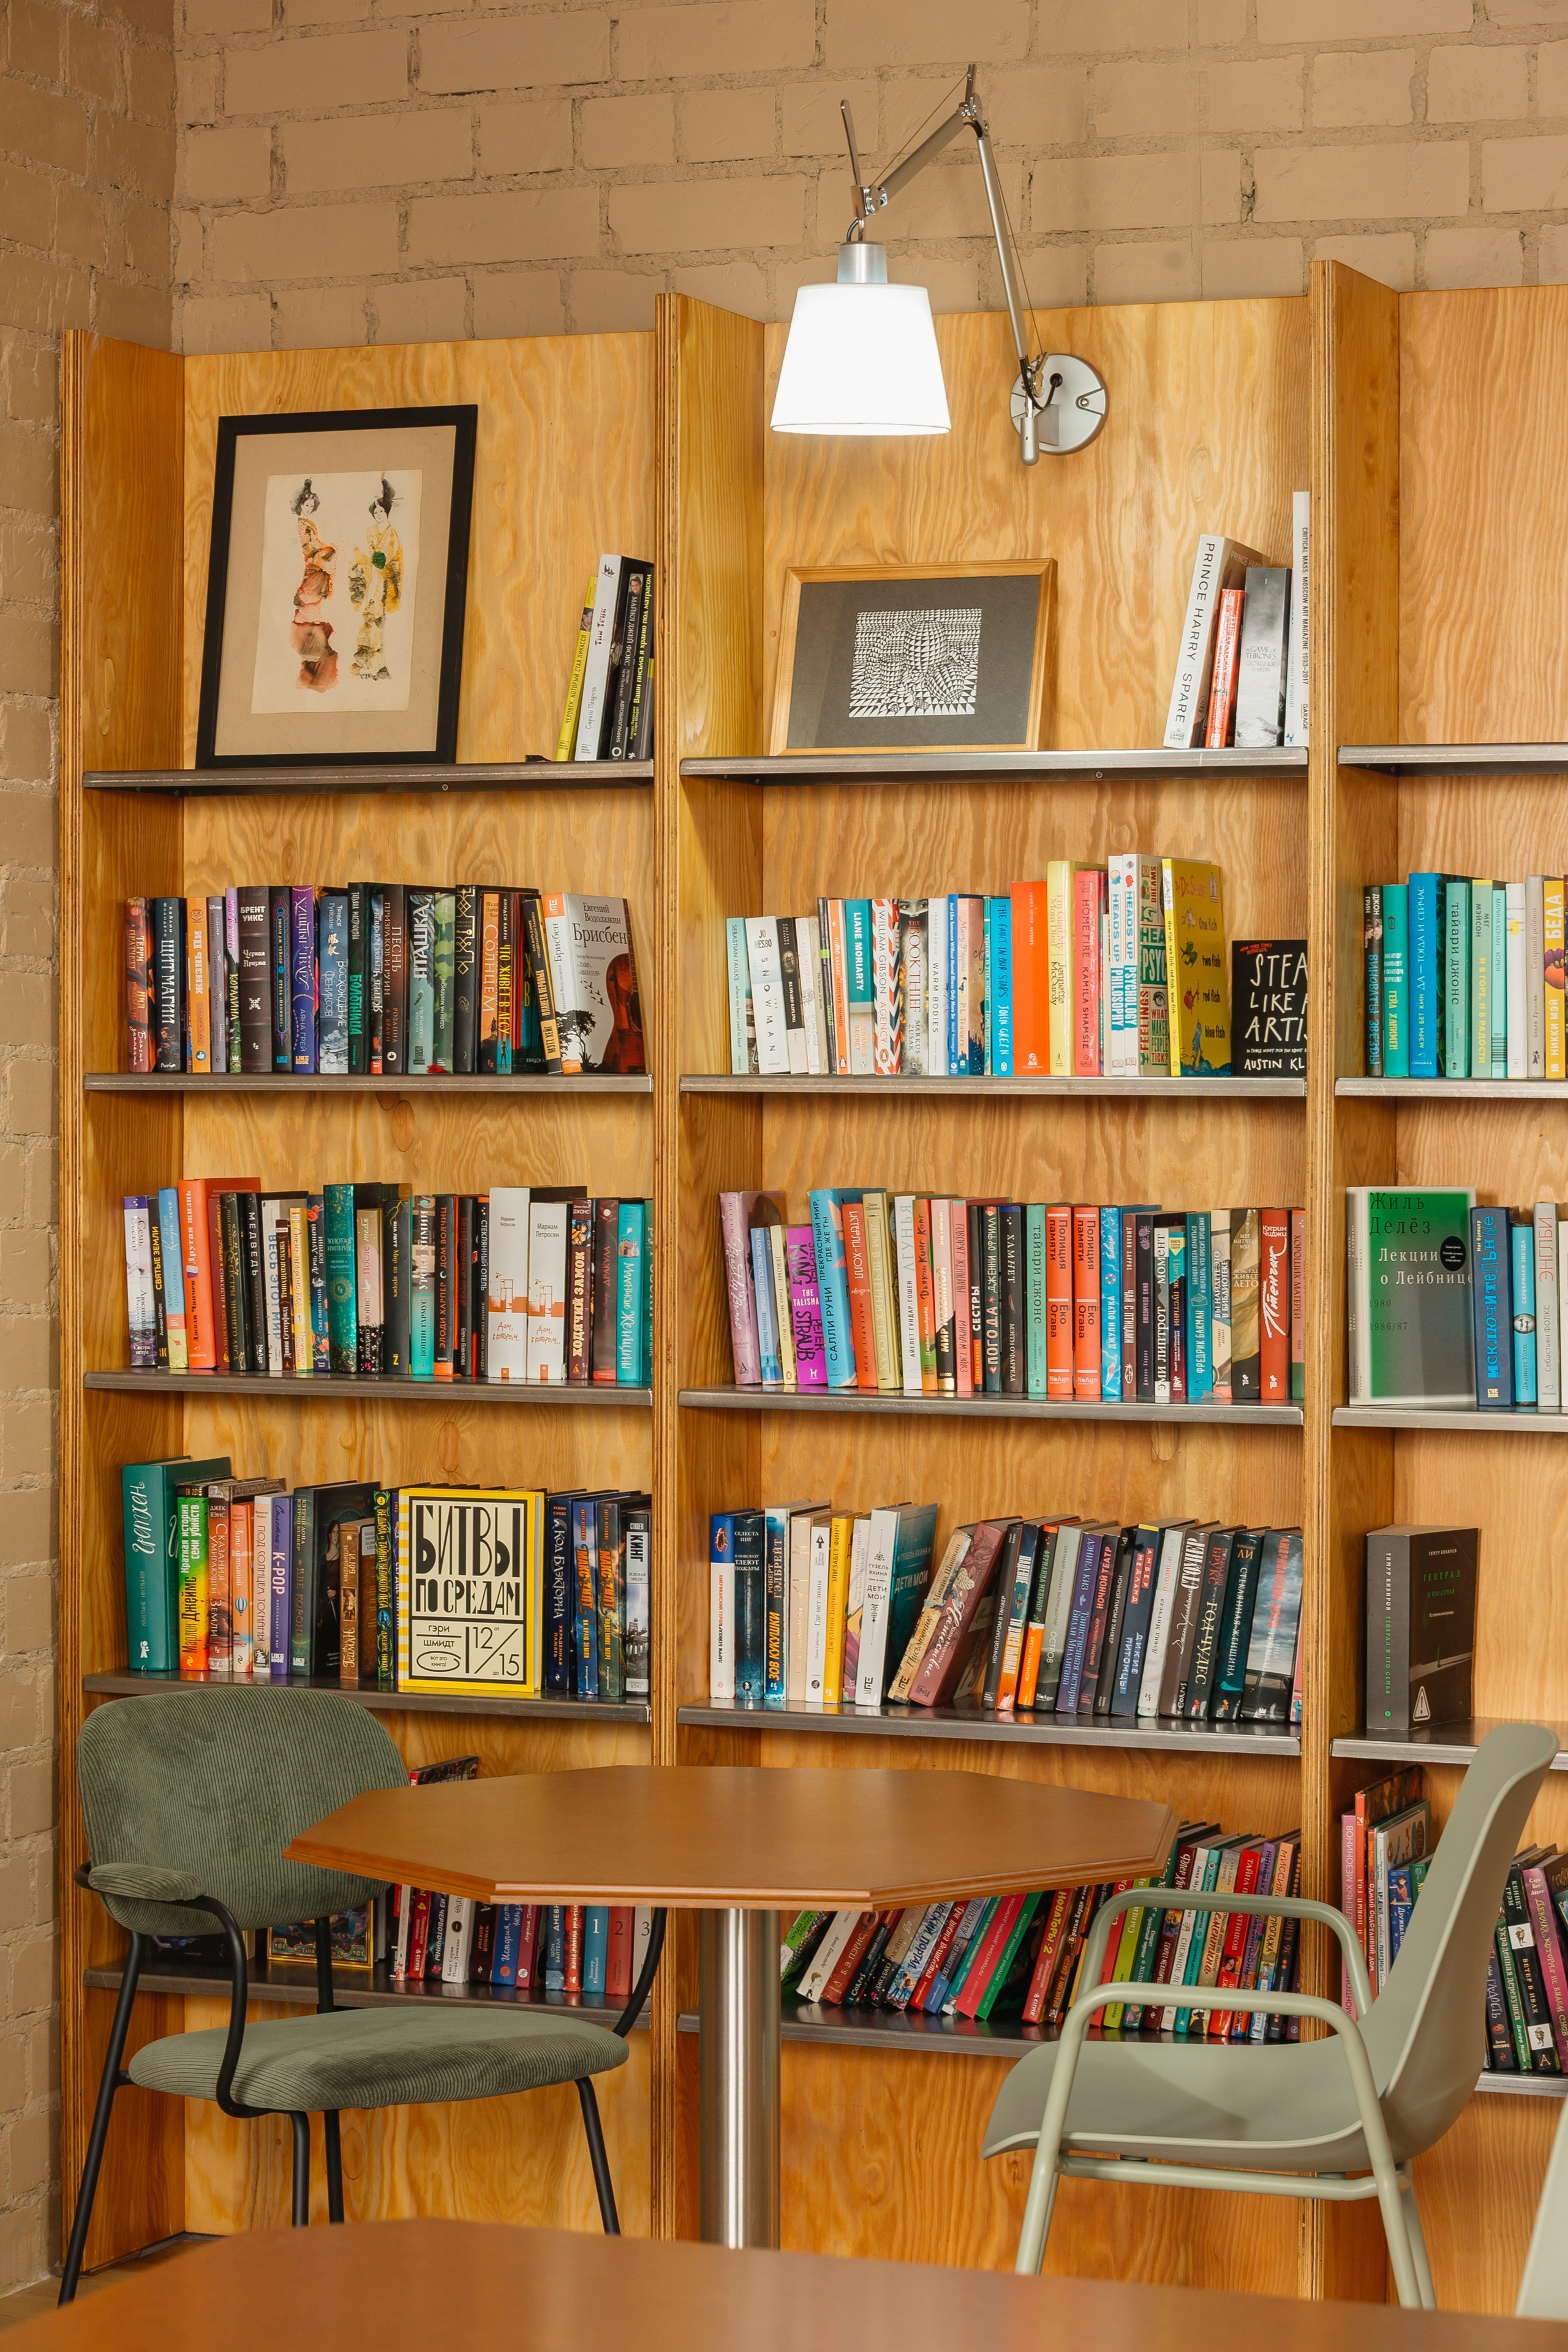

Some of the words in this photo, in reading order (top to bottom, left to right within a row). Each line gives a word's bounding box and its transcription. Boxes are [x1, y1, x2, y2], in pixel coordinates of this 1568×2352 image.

[1197, 543, 1215, 601] PRINCE
[576, 635, 587, 658] ПИКАССО
[639, 625, 648, 649] храню
[1186, 608, 1203, 661] HARRY
[570, 674, 579, 698] КОТОРЫЙ
[1175, 673, 1193, 723] SPARE
[565, 699, 576, 723] ЧЕЛОВЕК,
[583, 902, 610, 913] Евгений
[585, 913, 621, 924] Водолазкин
[1415, 886, 1425, 920] СЕЙЧАС
[1545, 894, 1562, 938] БЕДА
[573, 923, 628, 948] Брисбен
[853, 912, 862, 939] LIANE
[160, 940, 174, 972] ЩИТ
[499, 944, 510, 960] ЧТО
[552, 922, 563, 962] Брисбен
[909, 927, 920, 968] BOOK
[1127, 941, 1134, 959] UP
[499, 965, 511, 997] ЖИВЁТ
[855, 942, 864, 990] MORIARTY
[1250, 952, 1308, 988] STEA
[909, 971, 921, 1012] THIEF
[999, 975, 1008, 997] STARS
[1124, 967, 1137, 1025] PSYCHOLOGY
[1368, 954, 1378, 1014] ВИНОВАТЫ
[1417, 976, 1425, 990] ДА
[161, 975, 175, 1024] МАГИИ
[349, 974, 362, 1035] БОЛОТНИЦА
[997, 1005, 1009, 1025] JOHN
[1250, 992, 1295, 1014] LIKE
[1389, 990, 1398, 1009] ГЕЙЛ
[1549, 999, 1559, 1019] МЭЙ
[498, 1011, 510, 1034] ЛЕСУ
[544, 1025, 554, 1037] ХЕЙГ
[1140, 990, 1148, 1050] FEELINGS
[1245, 1016, 1308, 1042] ARTI
[1389, 1013, 1398, 1050] ХАНИМЕН
[546, 1038, 556, 1053] МЭТТ
[999, 1028, 1009, 1055] GREEN
[1369, 1019, 1379, 1065] ЗВЕЗДЫ
[1550, 1023, 1559, 1055] НИККИ
[1244, 1058, 1282, 1071] AUSTIN
[1370, 1192, 1425, 1209] Жиль
[1370, 1216, 1431, 1236] Делёз
[248, 1212, 258, 1276] МЕДВЕДЬ
[848, 1211, 864, 1279] ИСТЕРЛИ-ХОЛЛ
[1058, 1219, 1067, 1269] Полиция
[1379, 1248, 1438, 1262] Лекции
[1539, 1218, 1553, 1281] ЭНГЛБИ
[154, 1257, 162, 1290] СВЯТЫЕ
[573, 1251, 585, 1295] ЗАМОК
[1381, 1275, 1388, 1284] о
[1396, 1271, 1472, 1285] Лейбнице
[824, 1287, 834, 1316] РУНИ
[971, 1286, 981, 1332] СЕСТРЫ
[1060, 1305, 1071, 1324] Ёко
[1106, 1296, 1115, 1319] ОЦУКА
[572, 1298, 585, 1357] ХОДЯЧИЙ
[795, 1311, 815, 1361] STRAUB
[986, 1306, 998, 1365] ПОГОДА
[1107, 1322, 1117, 1349] ДЖУЛИ
[1195, 1310, 1205, 1338] БАКМАН
[828, 1321, 838, 1361] САЛЛИ
[1196, 1340, 1205, 1374] ФРЕДРИК
[190, 1505, 201, 1536] убийств
[181, 1540, 190, 1573] Краткая
[191, 1539, 200, 1559] семи
[416, 1505, 520, 1578] БИТВЫ
[630, 1535, 643, 1562] КИНГ
[272, 1552, 285, 1594] K-POP
[774, 1539, 782, 1599] ГЭЛБРЕЙТ
[1101, 1547, 1112, 1572] ТЕАТР
[1181, 1538, 1205, 1589] СТОУНЕР
[181, 1577, 200, 1621] Джеймс
[416, 1579, 438, 1612] ПО
[444, 1579, 520, 1616] СРЕДАМ
[1095, 1575, 1109, 1609] НОЧНОЙ
[181, 1623, 197, 1653] Марлон
[423, 1639, 455, 1648] шмидт
[428, 1625, 450, 1636] гэри
[473, 1627, 492, 1649] 12
[769, 1612, 780, 1660] КУКУШКИ
[907, 1615, 932, 1667] Письмовник
[1047, 1631, 1056, 1663] ОСТРОВ
[499, 1654, 519, 1676] 15
[769, 1662, 779, 1681] ЗОВ
[1344, 1825, 1354, 1883] МЕЗОНИНОВ
[501, 1922, 511, 1961] История,
[848, 1933, 867, 1959] ПЭРИС
[978, 1945, 997, 1976] ПУТЕШЕСТВИЯ
[990, 1923, 1005, 1945] ДОКТОРА
[1000, 1898, 1016, 1922] ДУЛИТТЛА
[1052, 1981, 1065, 2008] ФРАНКЛИН
[1060, 1954, 1071, 1975] ДИКСОН
[1498, 1927, 1514, 1976] Украденная
[1509, 1977, 1521, 2021] деревушка
[1522, 1959, 1532, 1983] ВЕТЕР
[1529, 1993, 1538, 2013] ИВАХ
